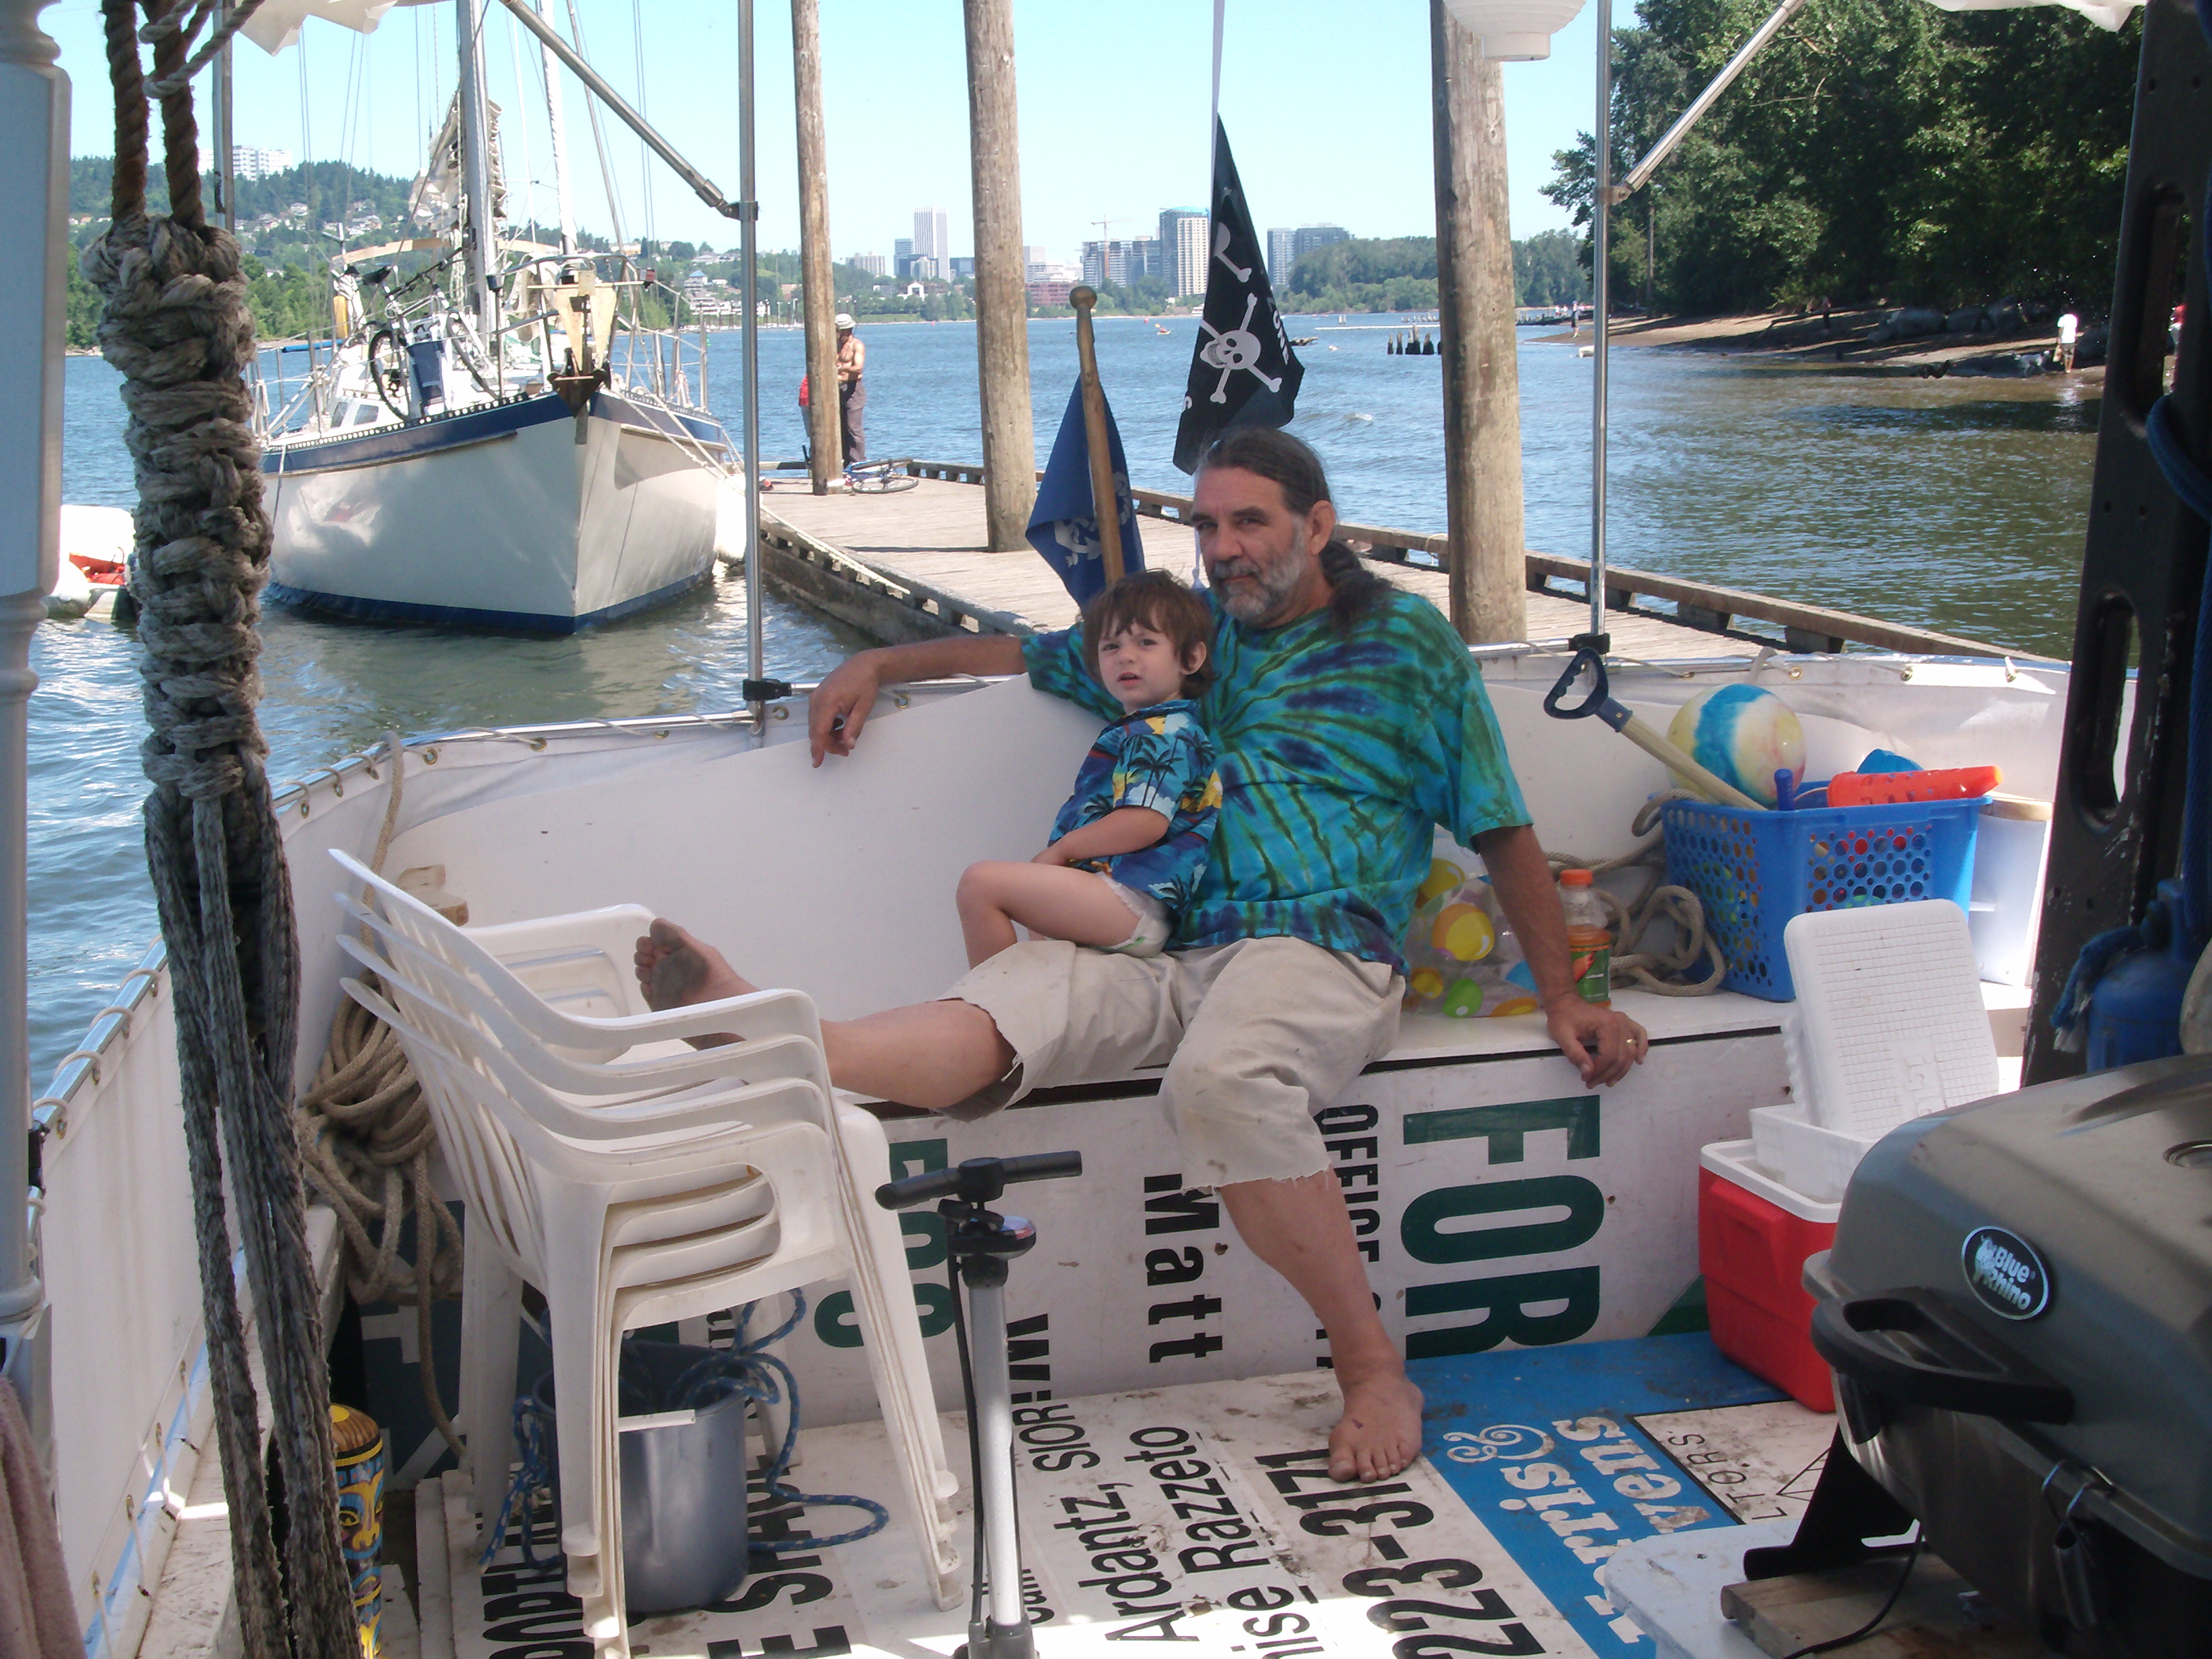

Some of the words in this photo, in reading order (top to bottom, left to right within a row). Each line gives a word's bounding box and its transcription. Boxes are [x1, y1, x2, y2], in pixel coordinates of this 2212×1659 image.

[1143, 1173, 1224, 1364] Matt
[1401, 1094, 1605, 1361] FOR
[1982, 1268, 2032, 1310] Rhino
[1994, 1246, 2030, 1284] Blue
[1012, 1403, 1101, 1472] SIOR
[1124, 1426, 1271, 1574] Razzeto
[1053, 1482, 1201, 1642] Ardantz,
